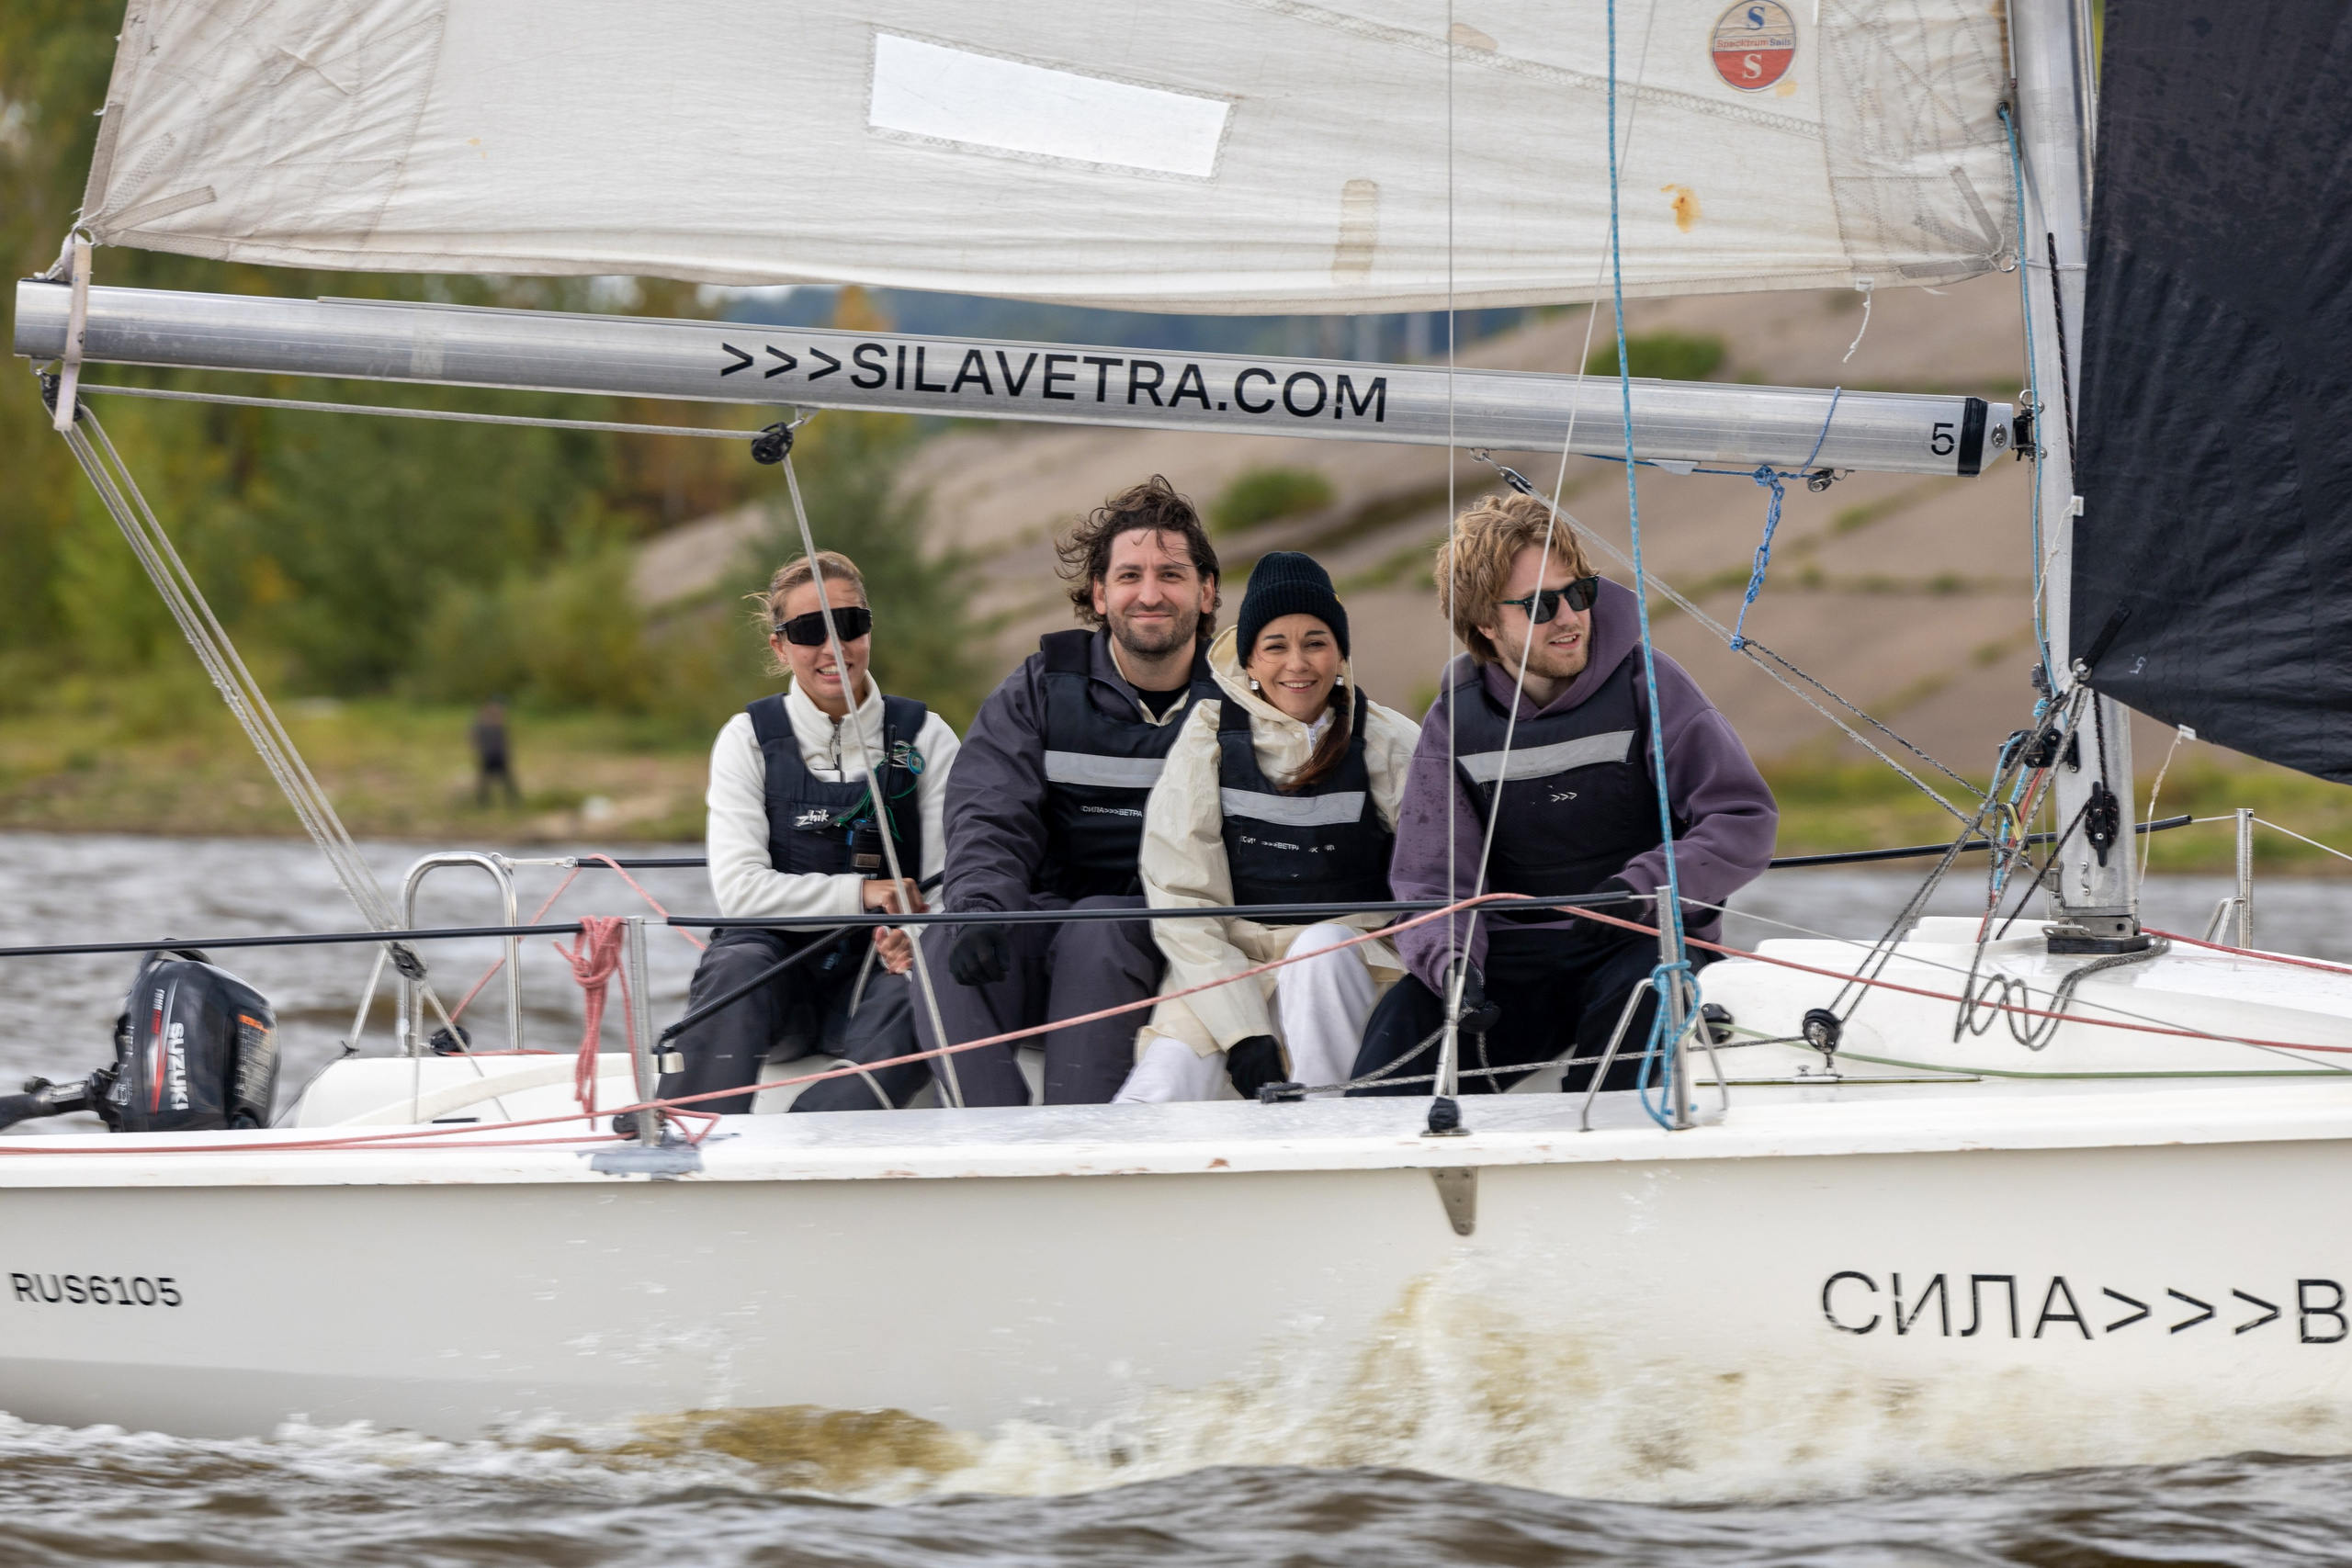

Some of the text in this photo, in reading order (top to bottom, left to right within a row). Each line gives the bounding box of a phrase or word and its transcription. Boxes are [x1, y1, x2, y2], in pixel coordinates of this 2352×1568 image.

[1747, 6, 1766, 30] S
[1742, 53, 1762, 79] S
[1931, 423, 1954, 456] 5
[168, 1022, 190, 1111] SUZUKI
[8, 1272, 183, 1307] RUS6105
